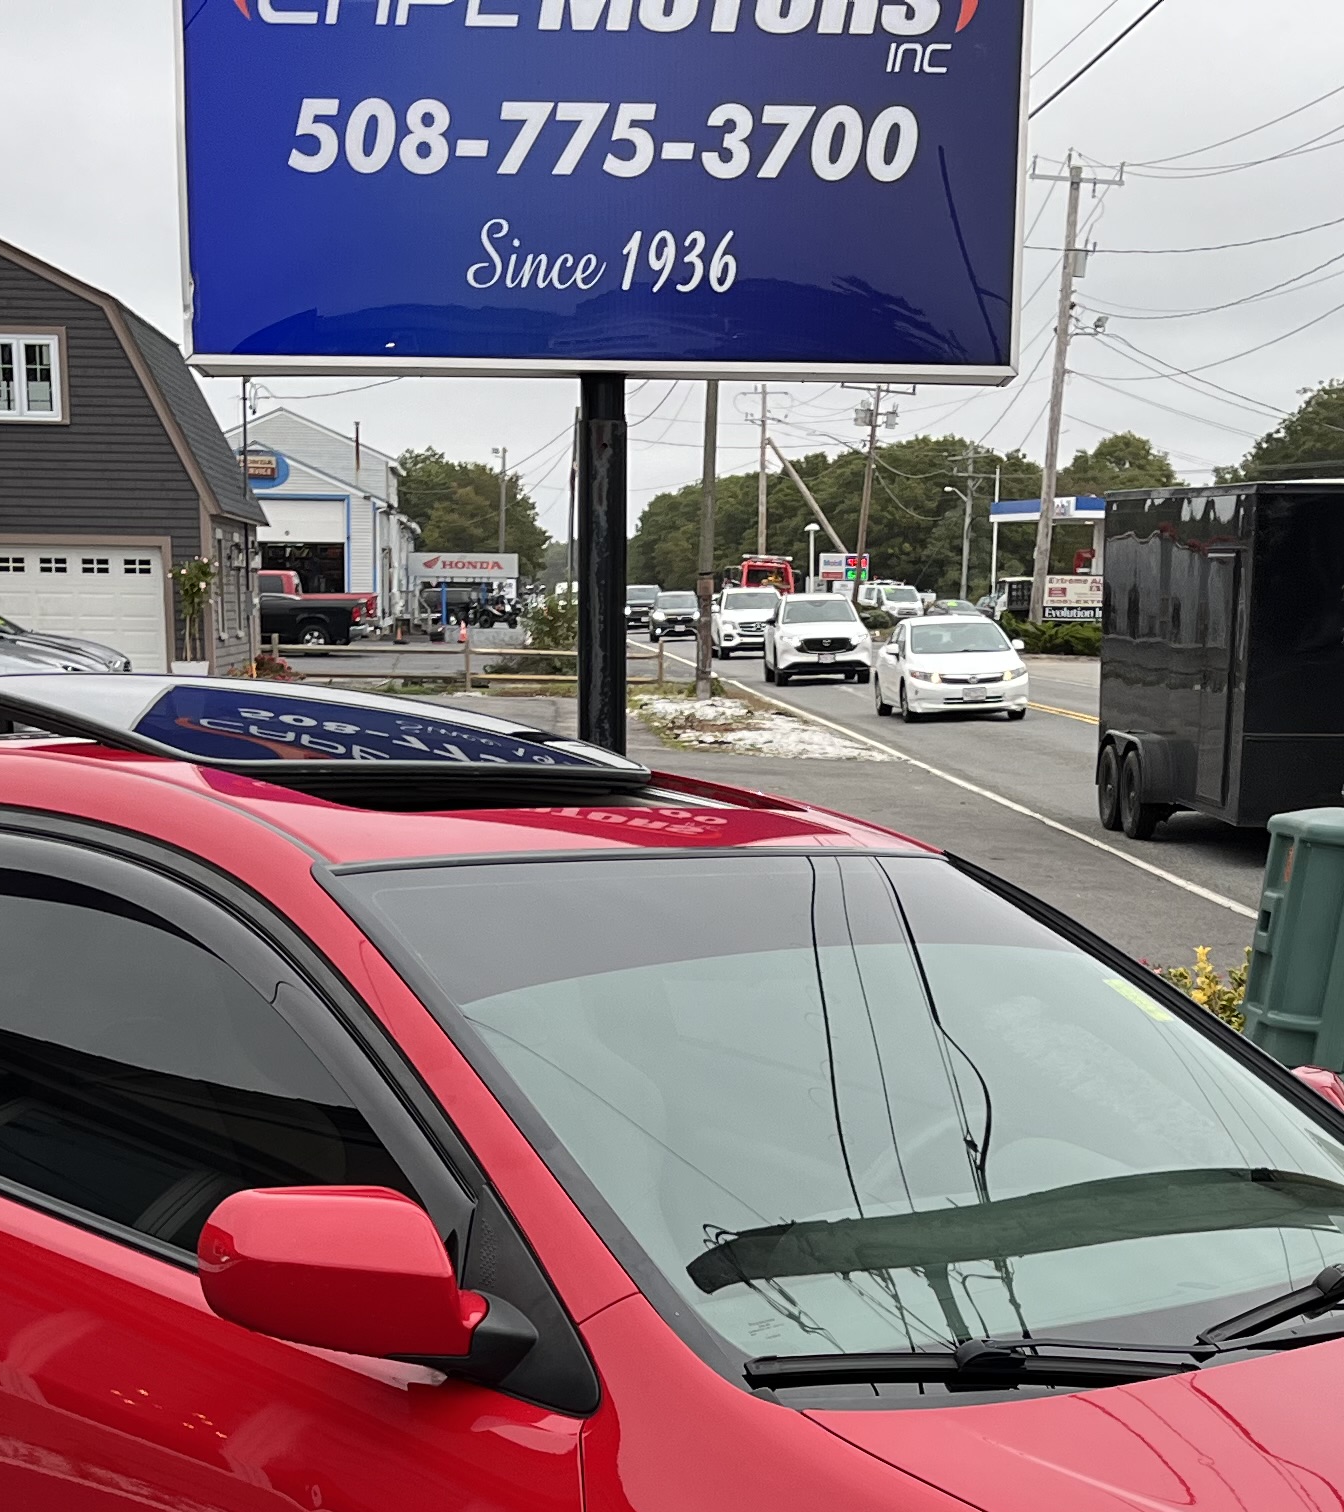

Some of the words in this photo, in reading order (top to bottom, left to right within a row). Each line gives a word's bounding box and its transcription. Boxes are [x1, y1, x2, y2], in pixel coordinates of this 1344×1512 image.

[885, 42, 952, 73] INC
[287, 97, 919, 182] 508-775-3700
[466, 218, 606, 290] Since
[621, 229, 738, 293] 1936
[441, 560, 504, 571] HONDA
[1044, 606, 1095, 618] Evolution
